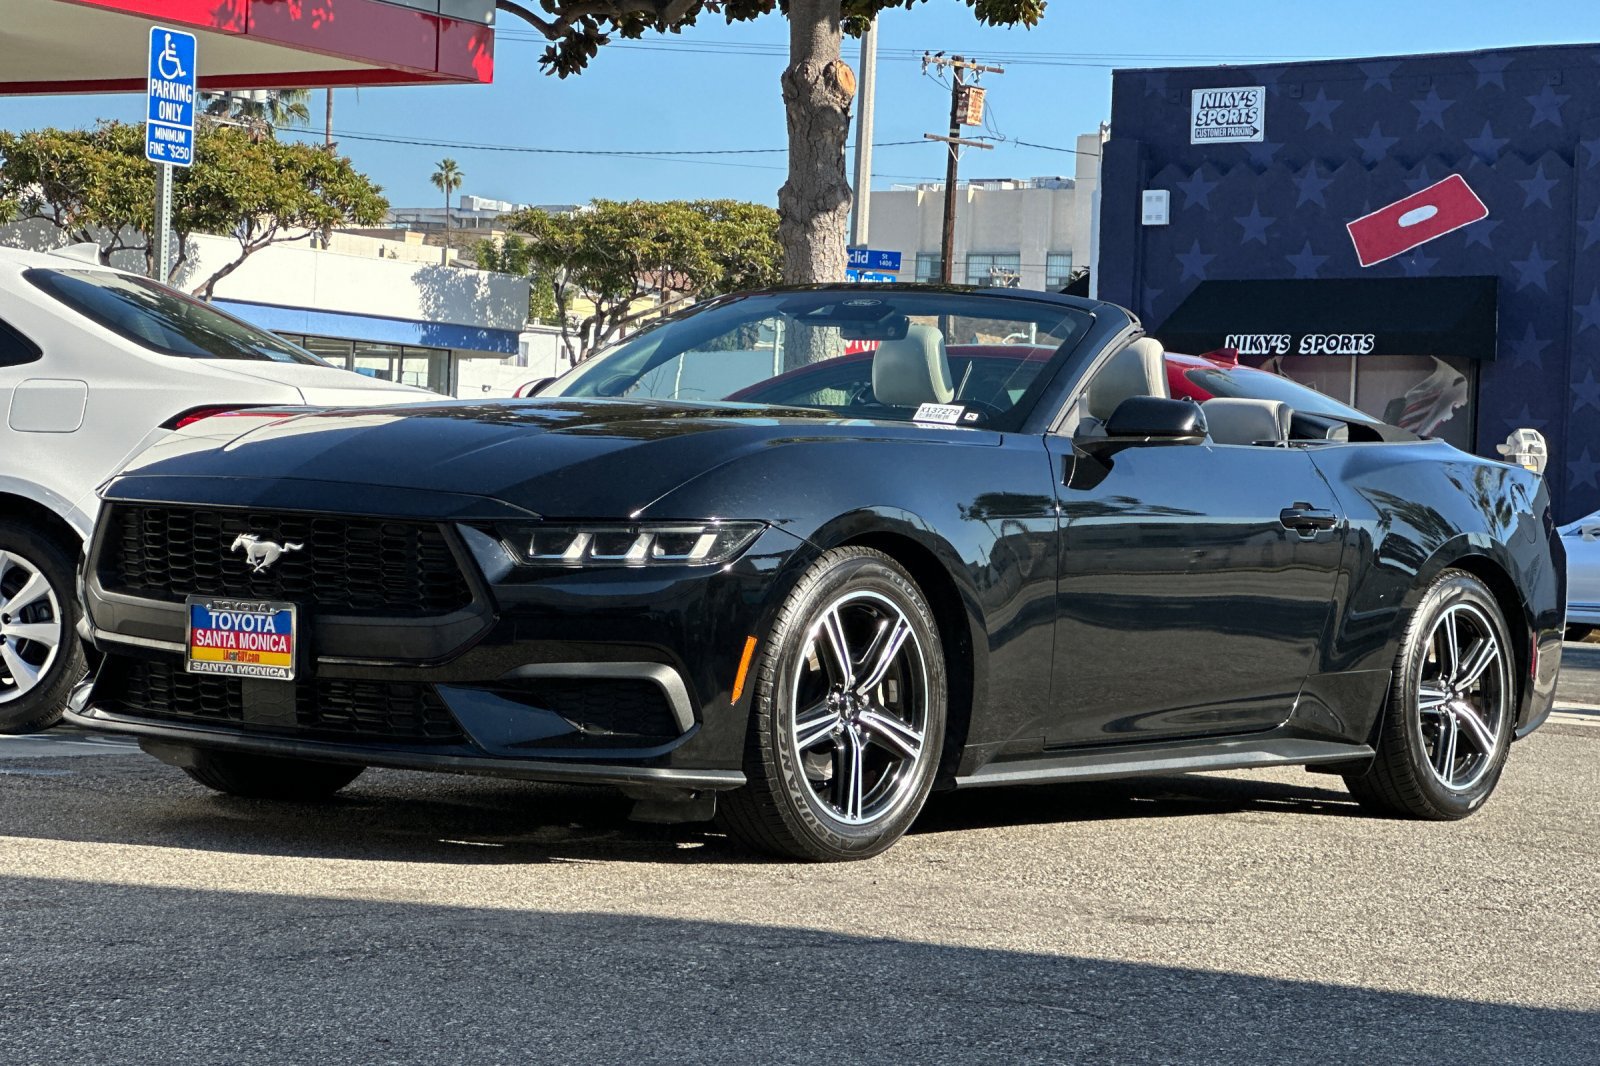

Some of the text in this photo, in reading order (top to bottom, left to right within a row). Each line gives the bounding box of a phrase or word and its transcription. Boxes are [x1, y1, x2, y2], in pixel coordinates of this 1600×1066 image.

[151, 79, 192, 103] PARKING
[1200, 91, 1258, 109] NIKY'S
[159, 101, 183, 122] ONLY
[1195, 107, 1259, 127] SPORTS
[155, 127, 185, 144] MINIMUM
[1196, 127, 1254, 138] CUSTOMER PARKING
[149, 142, 165, 156] FINE
[849, 250, 869, 264] clid
[1225, 334, 1375, 355] NIKY'S SPORTS
[919, 406, 960, 416] X137279
[213, 600, 268, 612] TOYOTA
[208, 611, 276, 633] TOYOTA
[196, 629, 287, 652] SANTA MONICA
[193, 662, 286, 677] SANTA MONICA
[777, 708, 855, 851] ASSURANCE
